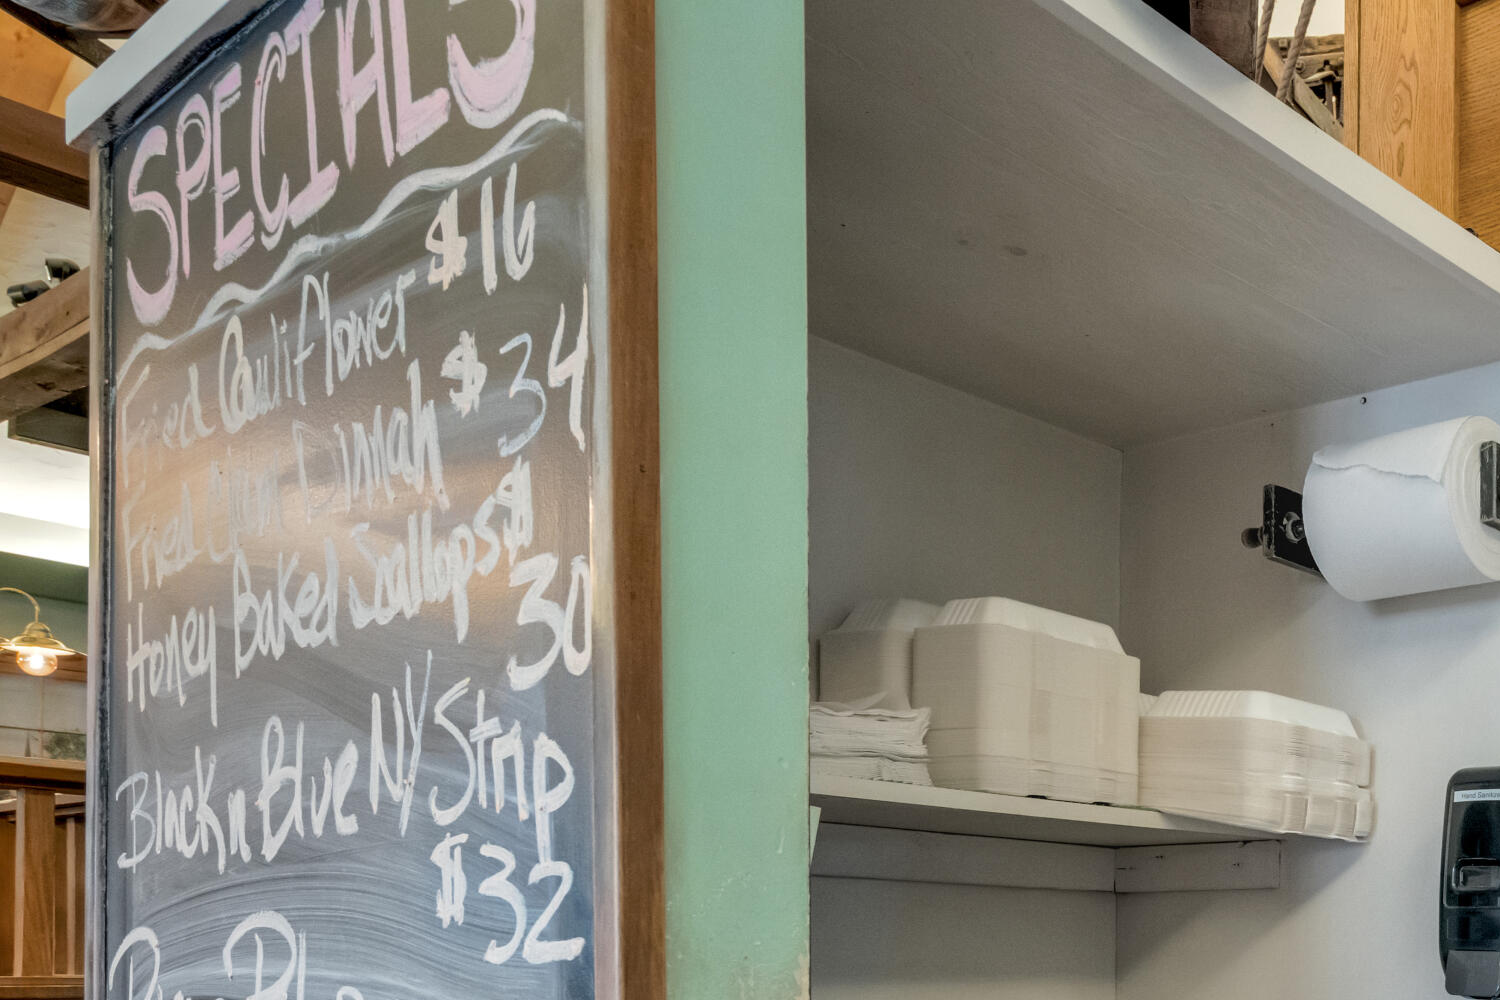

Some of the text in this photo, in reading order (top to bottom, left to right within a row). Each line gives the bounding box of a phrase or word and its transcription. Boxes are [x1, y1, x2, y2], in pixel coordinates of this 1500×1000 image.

[126, 0, 535, 326] SPECIALS
[120, 163, 536, 488] Fried Cauliflower $16
[120, 478, 200, 602] Fried
[441, 281, 589, 457] $34
[126, 604, 218, 726] Honey
[234, 537, 339, 679] Baked
[349, 491, 506, 643] Scallops
[257, 715, 361, 863] Blue
[369, 649, 434, 837] NY
[429, 677, 575, 866] Strip
[430, 833, 586, 965] $32
